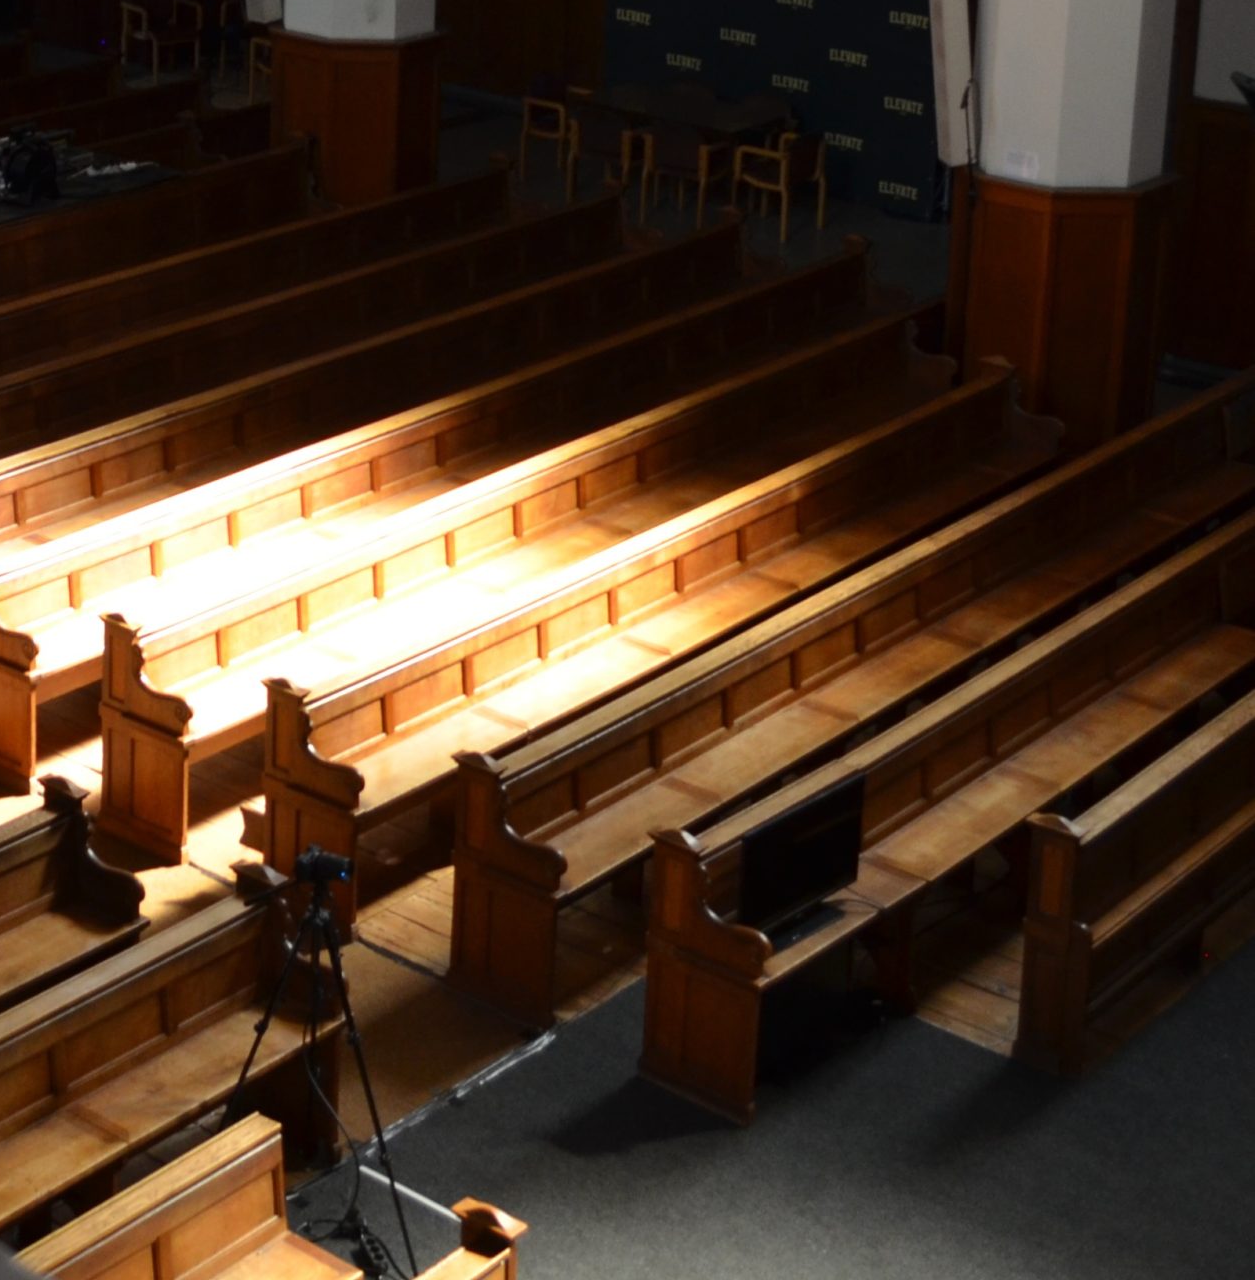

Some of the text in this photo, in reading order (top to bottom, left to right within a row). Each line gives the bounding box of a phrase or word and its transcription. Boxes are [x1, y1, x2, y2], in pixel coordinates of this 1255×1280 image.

[615, 7, 651, 26] ELEVATE
[889, 11, 930, 29] ELEVATE
[719, 27, 756, 46] ELEVATE
[665, 52, 701, 71] ELEVATE
[828, 47, 867, 67] ELEVATE
[771, 73, 809, 92] ELEVATE
[883, 95, 924, 115] ELEVATE
[877, 179, 918, 200] ELEVATE
